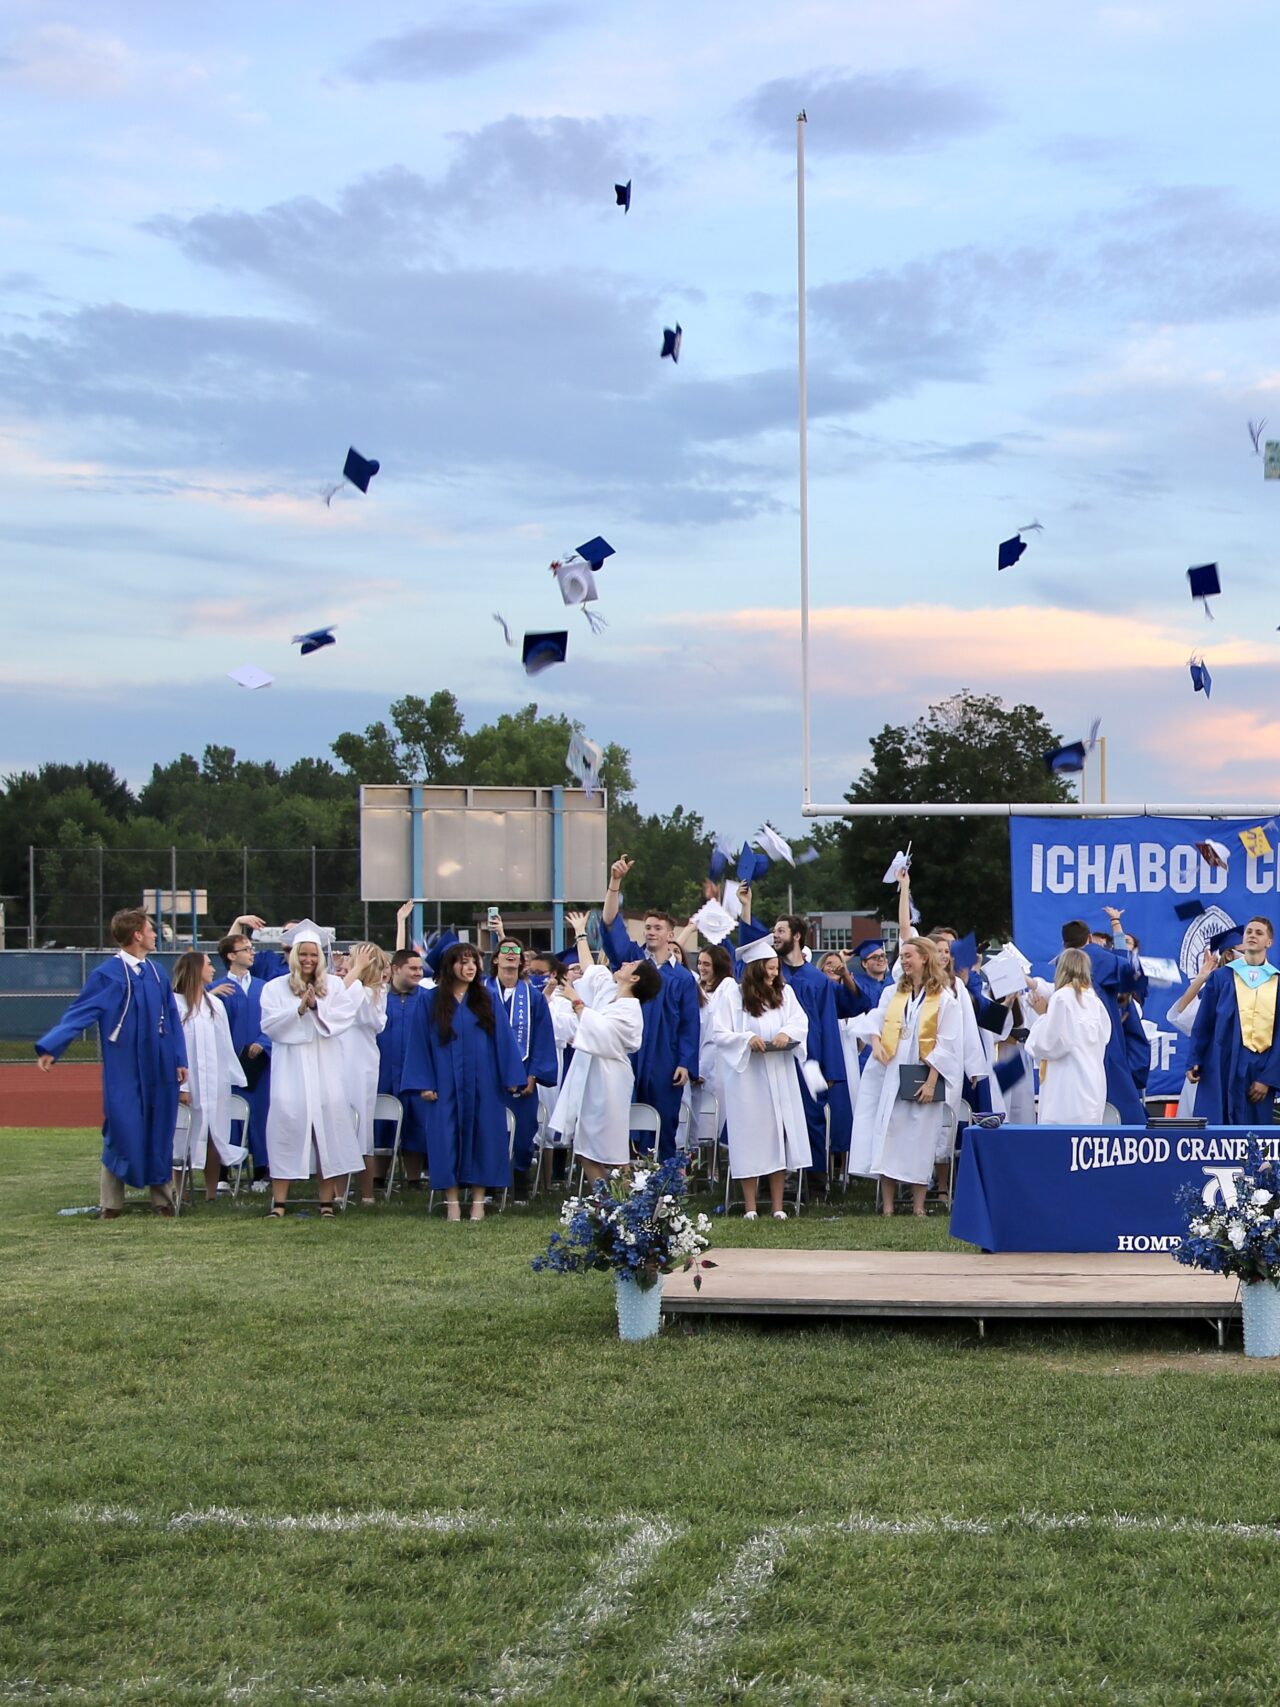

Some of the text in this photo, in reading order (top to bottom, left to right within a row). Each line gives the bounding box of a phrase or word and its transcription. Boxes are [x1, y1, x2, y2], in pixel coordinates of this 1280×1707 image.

[1031, 843, 1229, 894] ICHABOD
[1070, 1136, 1171, 1172] ICHABOD
[1177, 1137, 1249, 1162] CRANE
[1117, 1235, 1183, 1251] HOME
